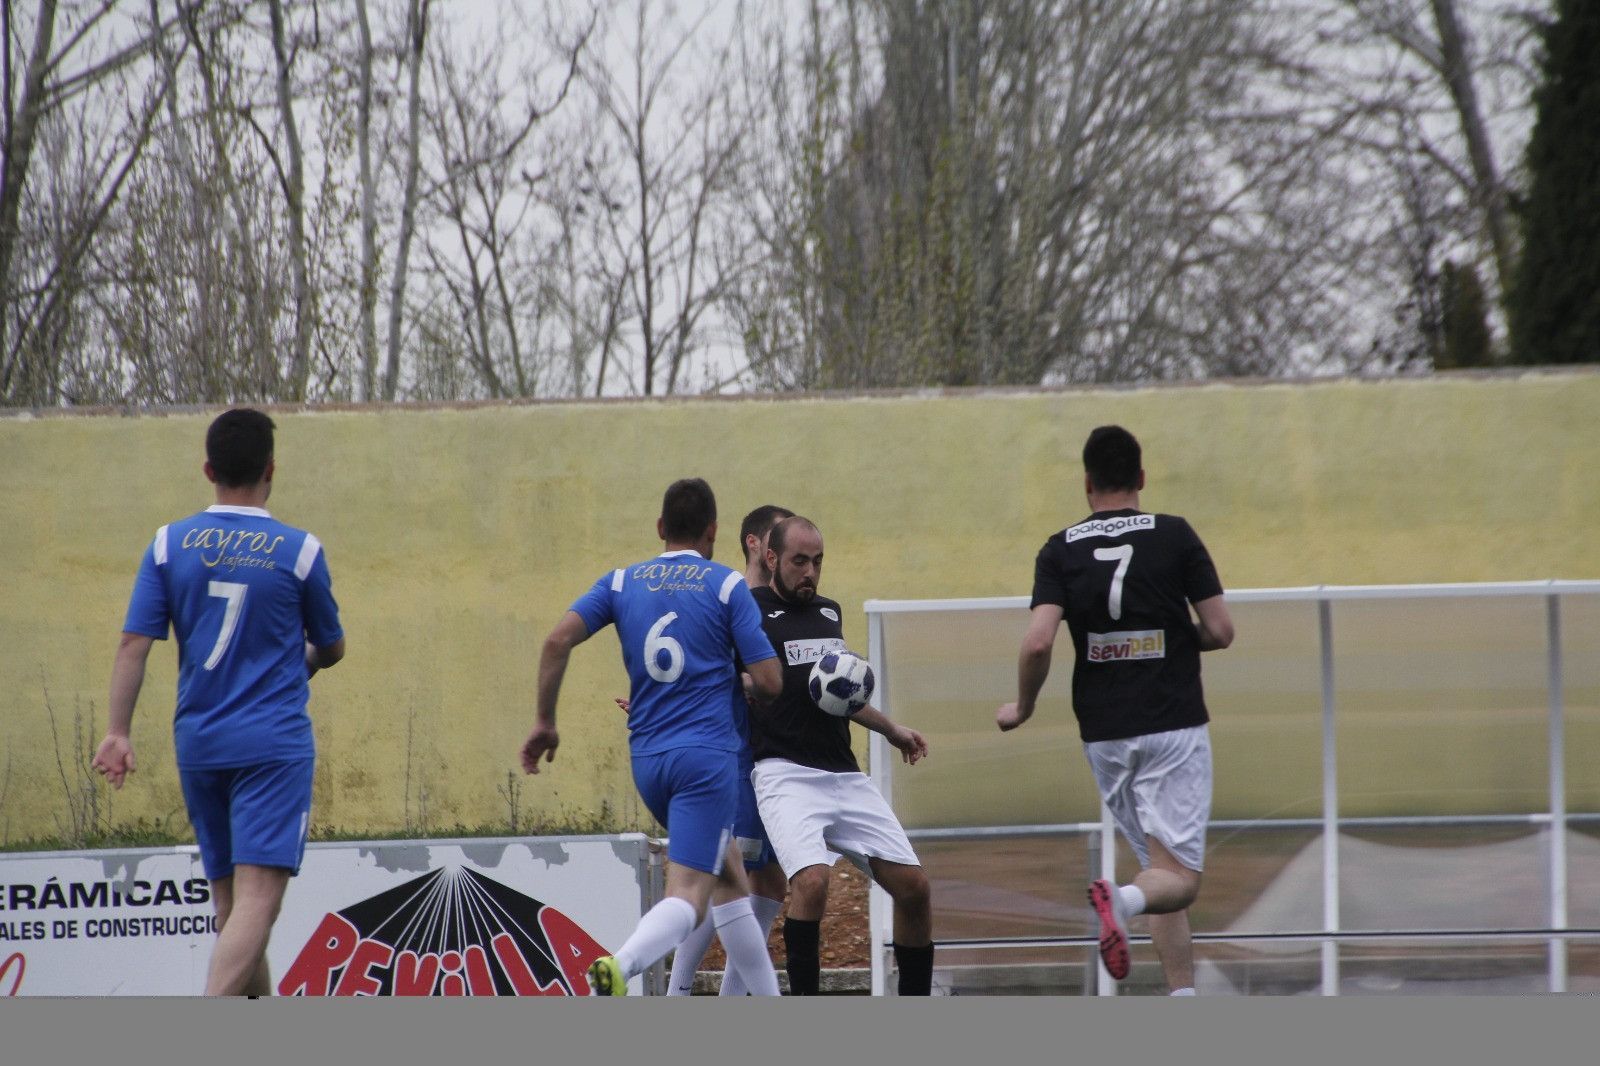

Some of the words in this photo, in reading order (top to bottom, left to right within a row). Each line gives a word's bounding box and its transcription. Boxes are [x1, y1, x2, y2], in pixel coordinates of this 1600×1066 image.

[1093, 544, 1134, 621] 7
[203, 580, 248, 671] 7
[644, 611, 685, 683] 6
[0, 876, 210, 910] RÁMICAS
[52, 920, 78, 939] DE
